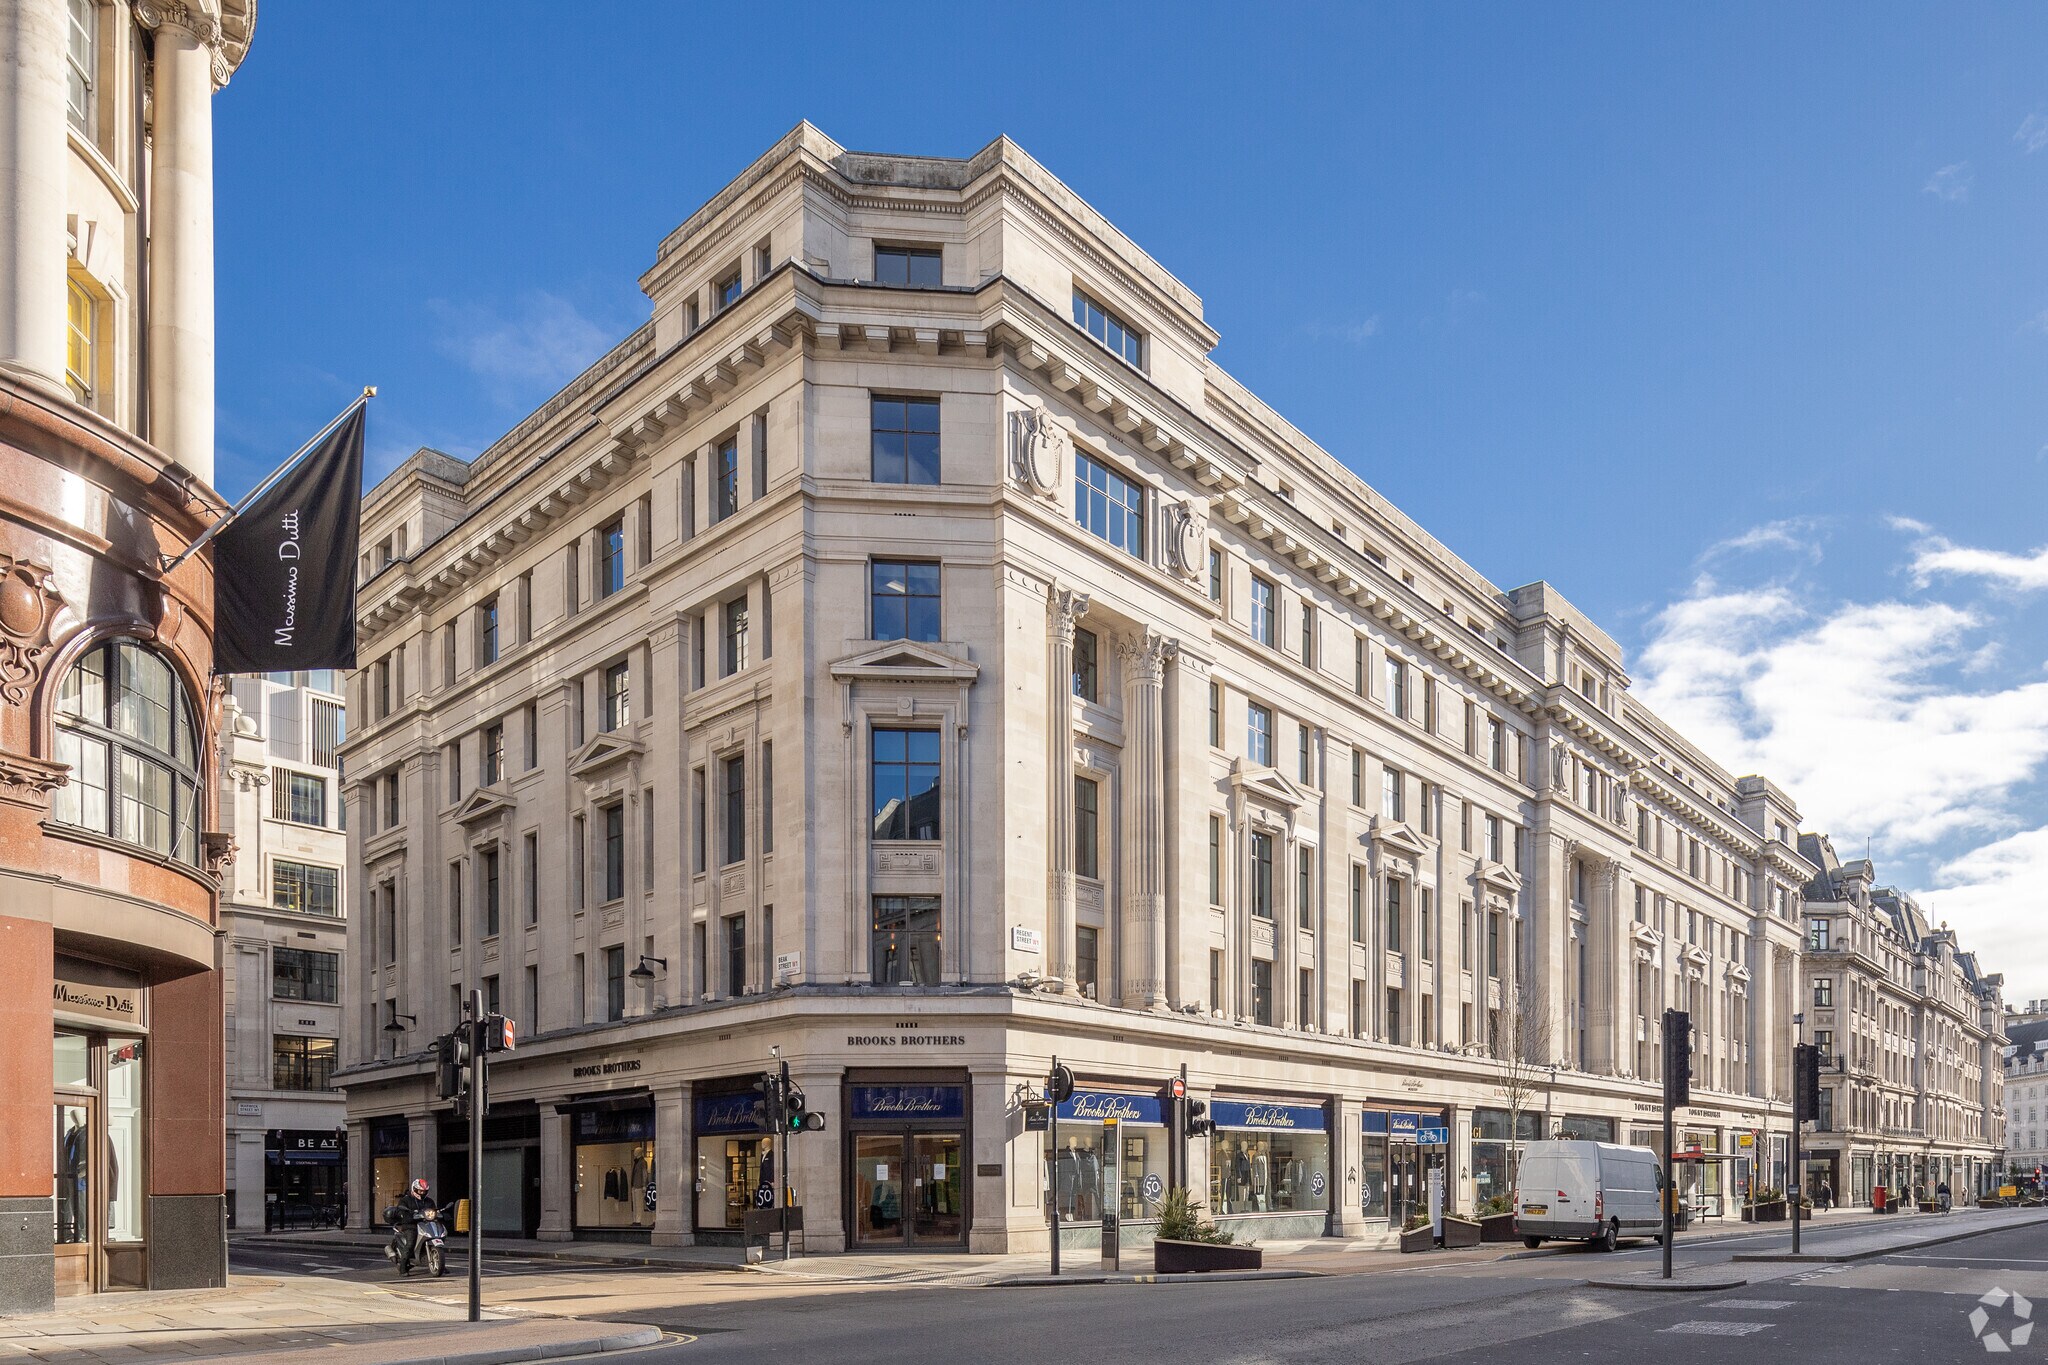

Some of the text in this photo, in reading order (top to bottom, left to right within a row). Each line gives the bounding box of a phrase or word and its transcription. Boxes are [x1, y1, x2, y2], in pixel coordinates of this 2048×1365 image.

[274, 509, 300, 646] Massimo Dutti
[1016, 929, 1032, 937] REGENT
[1016, 936, 1032, 944] STREET
[847, 1035, 965, 1046] BROOKS BROTHERS
[573, 1060, 641, 1078] BROOKS BROTHERS
[873, 1096, 942, 1113] Brooks Brothers
[1073, 1094, 1142, 1120] Brooks Brothers
[1245, 1106, 1295, 1128] Brooks Brothers
[298, 1139, 337, 1149] BE AT
